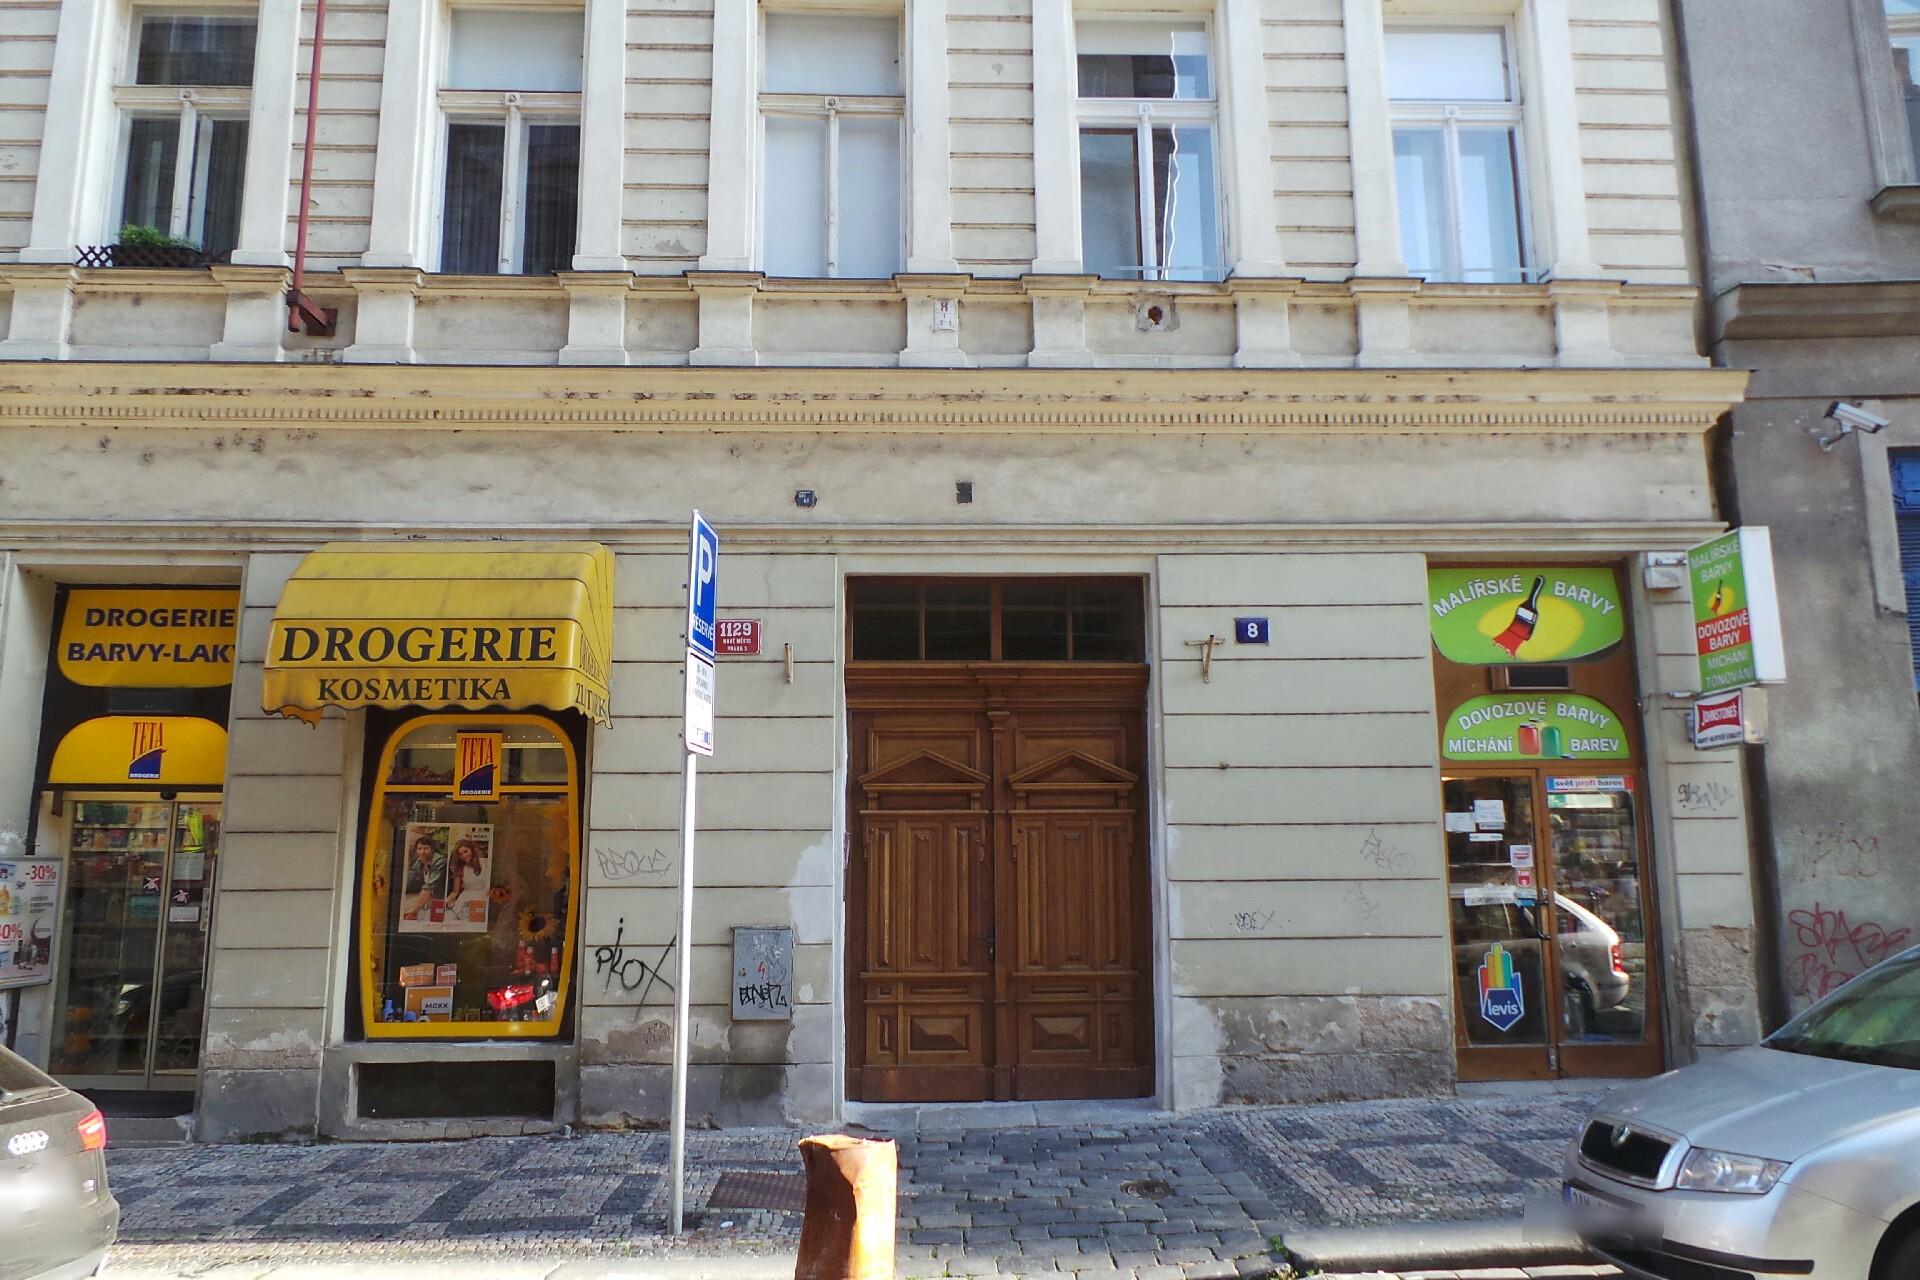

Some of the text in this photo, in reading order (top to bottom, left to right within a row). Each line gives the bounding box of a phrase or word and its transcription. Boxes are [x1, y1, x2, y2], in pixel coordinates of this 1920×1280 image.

[697, 533, 713, 607] P
[1701, 559, 1733, 583] BARVY
[1432, 574, 1615, 617] MALÍŘSKÉ BARVY
[85, 608, 235, 628] DROGERIE
[1698, 610, 1749, 640] DOVOZOVÉ
[720, 622, 752, 637] 1129
[1247, 622, 1259, 639] 8
[279, 626, 557, 662] DROGERIE
[1709, 631, 1741, 651] BARVY
[67, 643, 236, 663] BARVY-LAK
[317, 677, 512, 701] KOSMETIKA
[1459, 698, 1610, 730] DOVOZOVÉ BARVY
[132, 721, 164, 761] TETA
[1448, 735, 1619, 752] MÍCHÁNÍ BAREV
[461, 737, 494, 777] TETA
[25, 865, 57, 880] -30%
[0, 923, 23, 940] 0%
[1487, 998, 1519, 1016] levis
